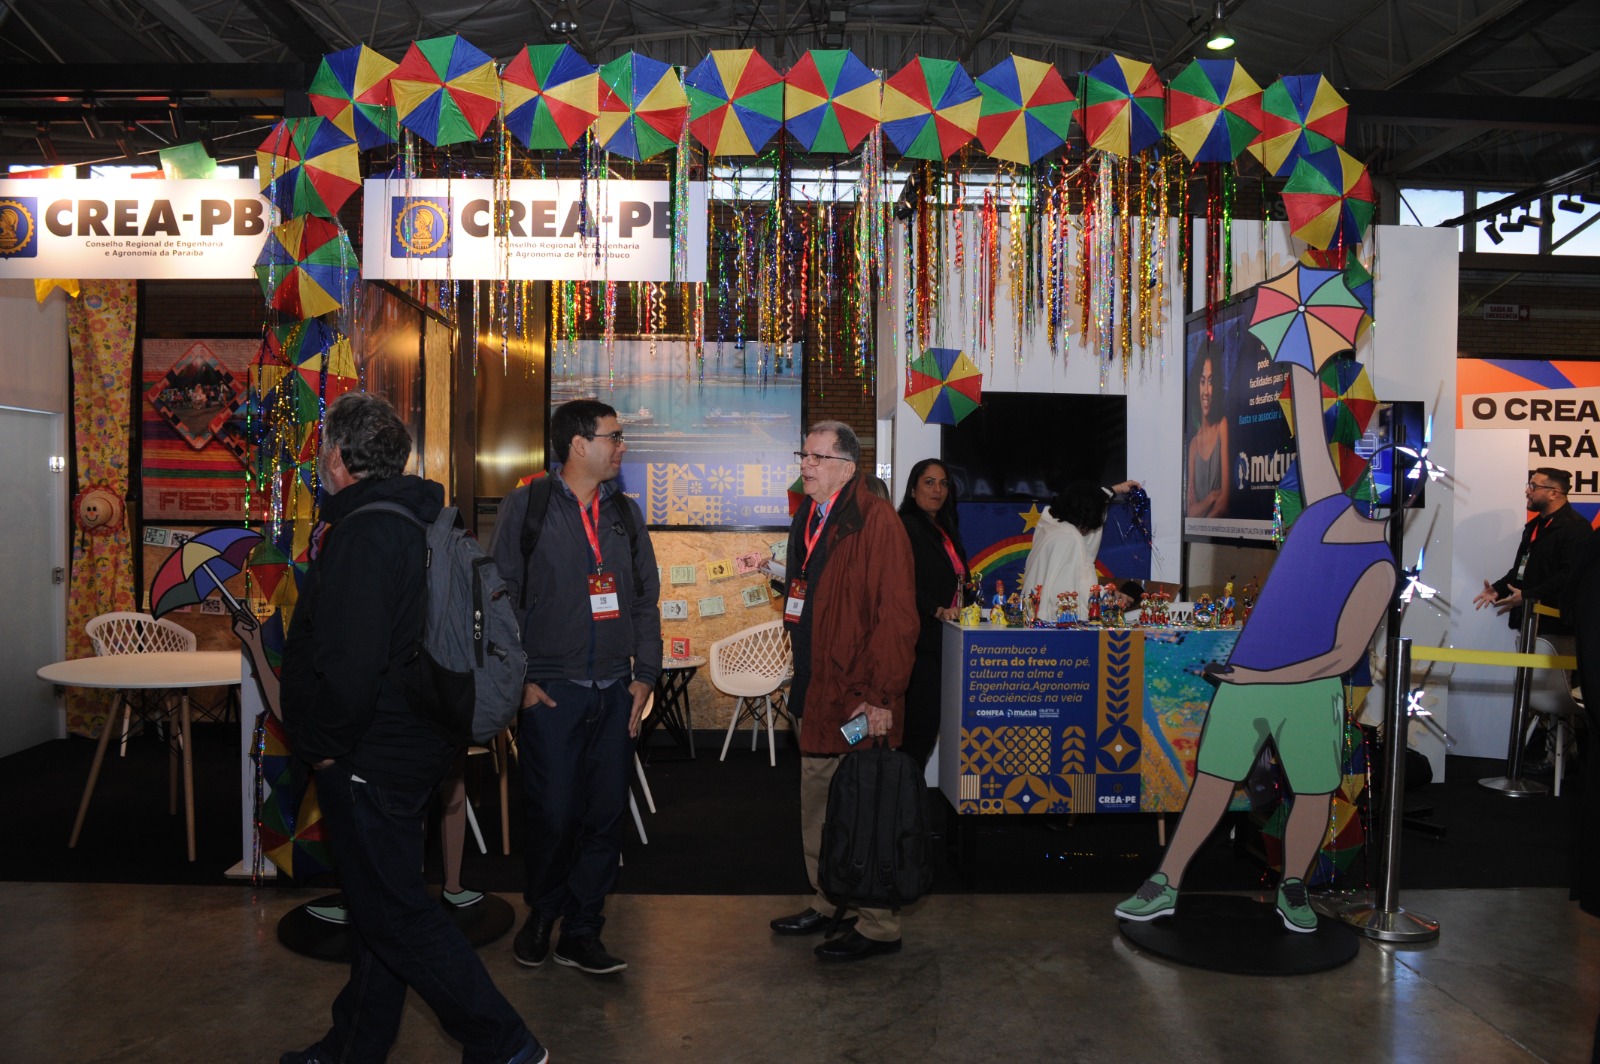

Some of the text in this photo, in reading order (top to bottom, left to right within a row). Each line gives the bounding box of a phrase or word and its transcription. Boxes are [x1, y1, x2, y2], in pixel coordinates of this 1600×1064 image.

[45, 198, 265, 237] CREA-PB
[85, 240, 223, 249] Conselho Regional de Engenharia
[540, 242, 577, 250] Regional
[112, 249, 157, 258] Agronomia
[159, 249, 170, 257] da
[516, 251, 562, 259] Agronomia
[1257, 358, 1270, 371] pode
[1249, 374, 1273, 388] facilidades
[1254, 392, 1274, 405] desafios
[1472, 397, 1600, 422] O CREA
[1238, 414, 1252, 425] Basta
[1252, 414, 1258, 423] se
[1258, 409, 1279, 422] associar
[1528, 429, 1599, 458] ARÁ
[753, 505, 789, 514] CREA-P
[970, 644, 1047, 655] Pernambuco é
[970, 656, 1091, 669] a terra do frevo no pé,
[970, 668, 1064, 679] cultura na alma e
[969, 692, 1083, 703] e Geociências na veia
[1098, 795, 1137, 804] CREA-PE
